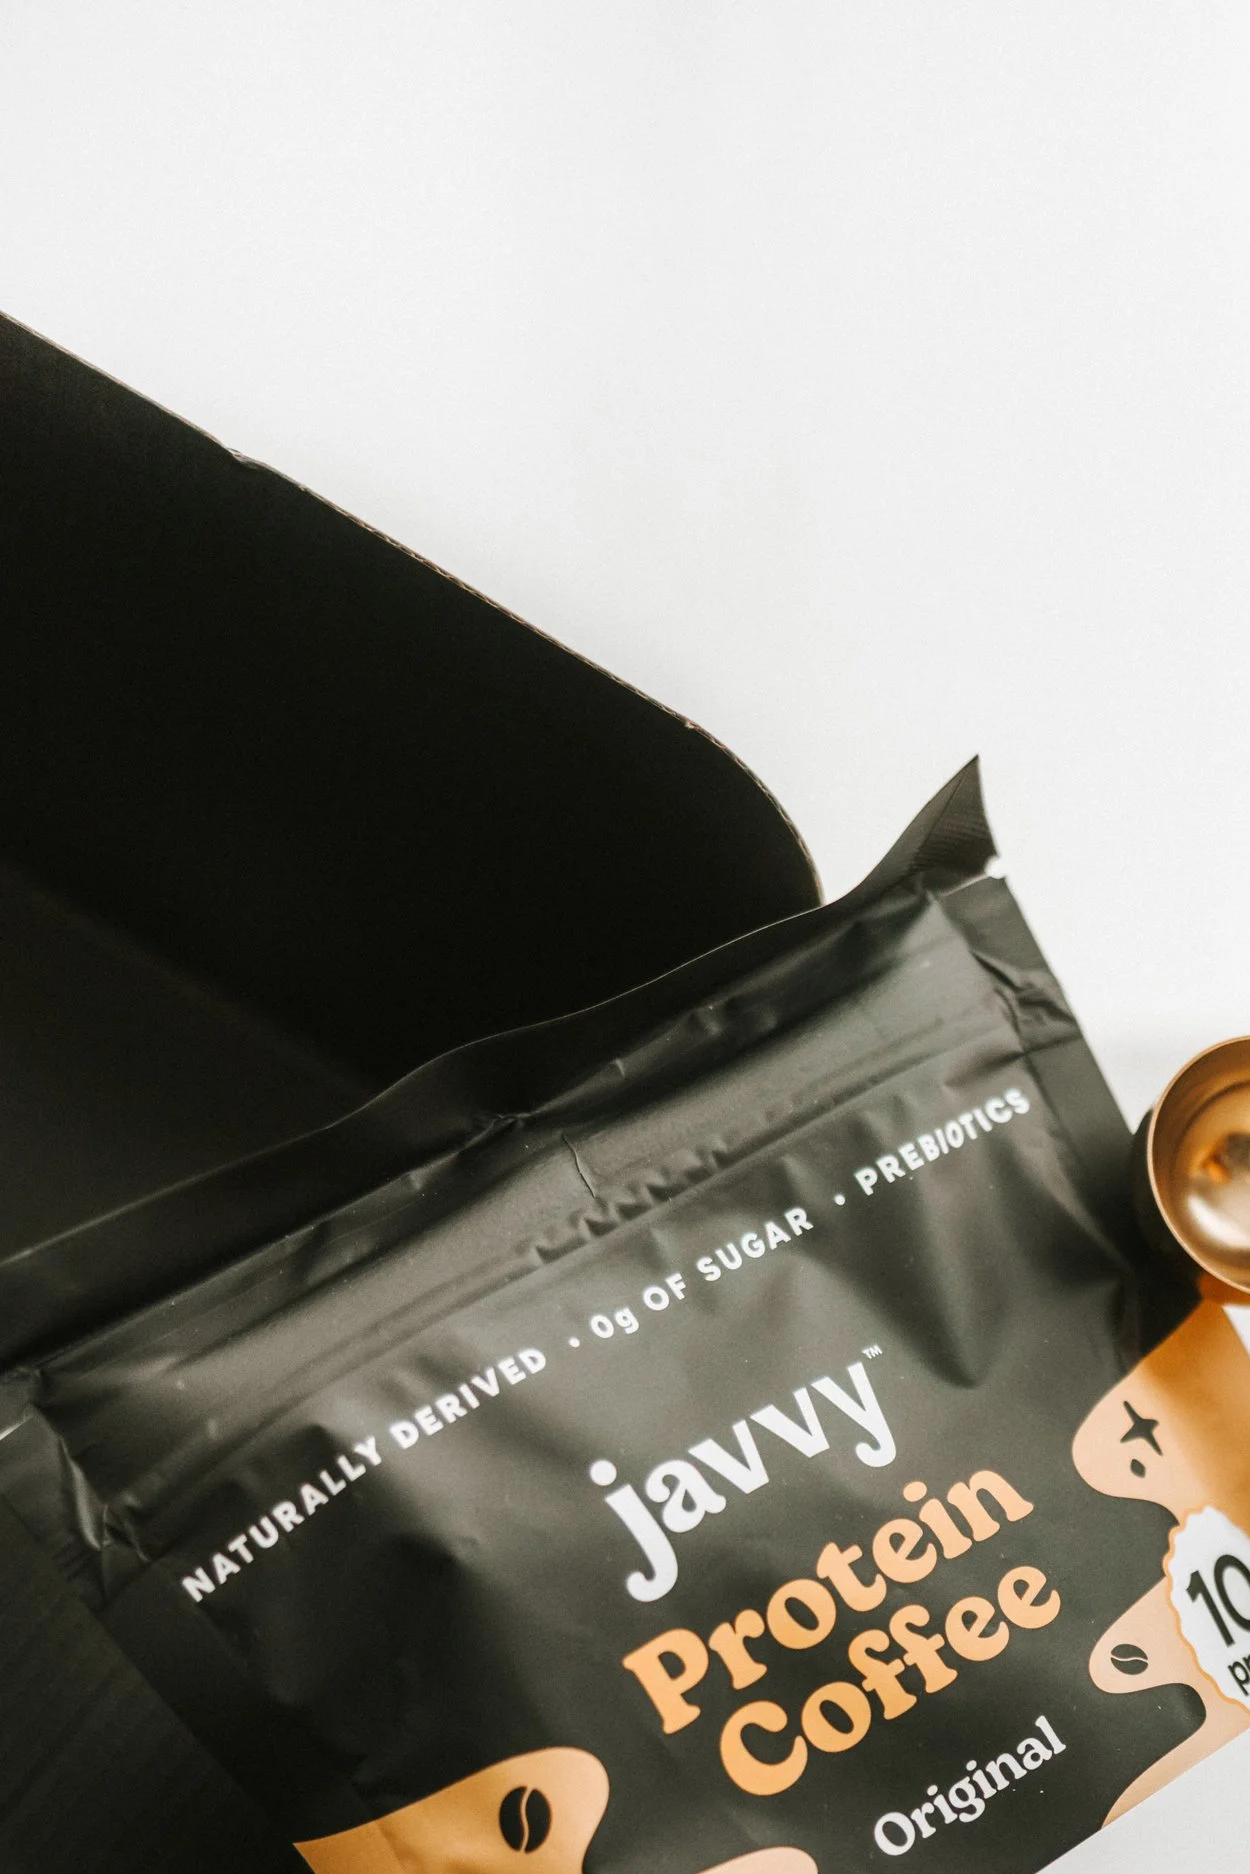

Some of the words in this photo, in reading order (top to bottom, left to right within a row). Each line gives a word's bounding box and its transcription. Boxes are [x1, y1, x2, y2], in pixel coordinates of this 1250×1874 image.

[181, 1436, 382, 1603] NATURALLY
[389, 1348, 546, 1449] DERIVED
[590, 1307, 639, 1338] 0g
[643, 1272, 687, 1311] OF
[696, 1207, 814, 1282] SUGAR
[854, 1088, 1030, 1196] PREBIOTICS
[589, 1361, 897, 1602] javvy
[622, 1469, 1034, 1735] Protein
[720, 1566, 1061, 1796] Coffee
[873, 1715, 1066, 1857] Original
